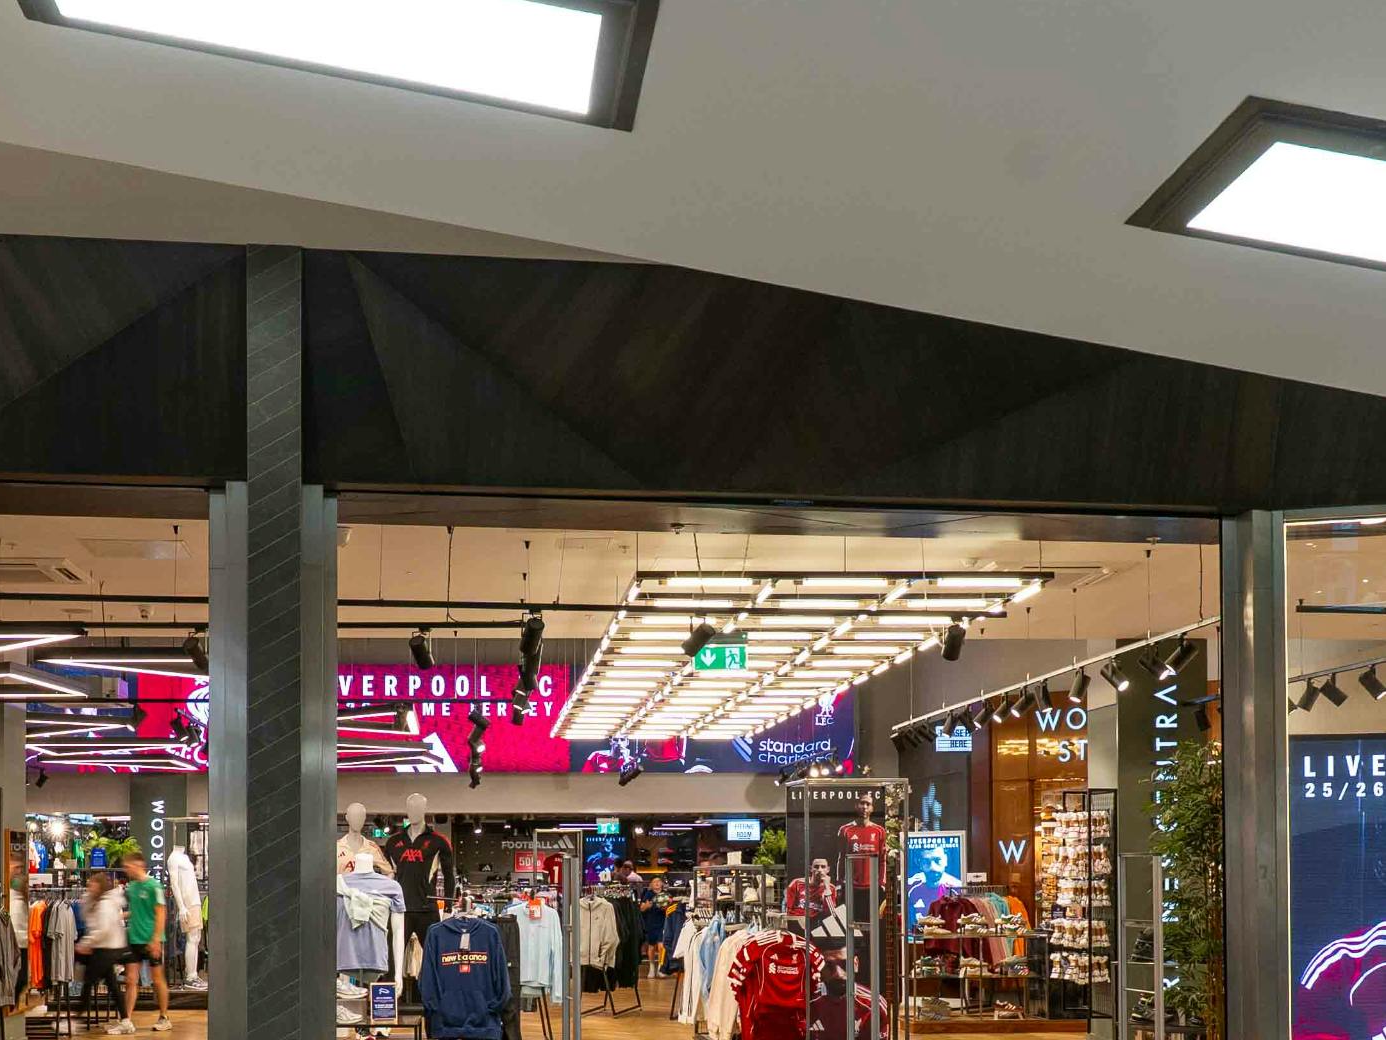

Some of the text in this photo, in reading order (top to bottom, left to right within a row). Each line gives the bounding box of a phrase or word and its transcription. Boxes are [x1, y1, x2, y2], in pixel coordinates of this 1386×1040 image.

[338, 675, 491, 697] VERPOOL
[422, 702, 554, 717] ME EREY
[1035, 707, 1087, 731] WO
[758, 738, 831, 754] standard
[950, 740, 967, 748] HERE
[1058, 739, 1087, 762] ST
[1304, 754, 1386, 778] LIVE
[1304, 781, 1384, 801] 25/26
[151, 799, 165, 861] ROOM
[501, 840, 551, 850] FOOTBALL
[998, 839, 1027, 864] W
[399, 848, 424, 863] AXA
[441, 953, 488, 963] new baance
